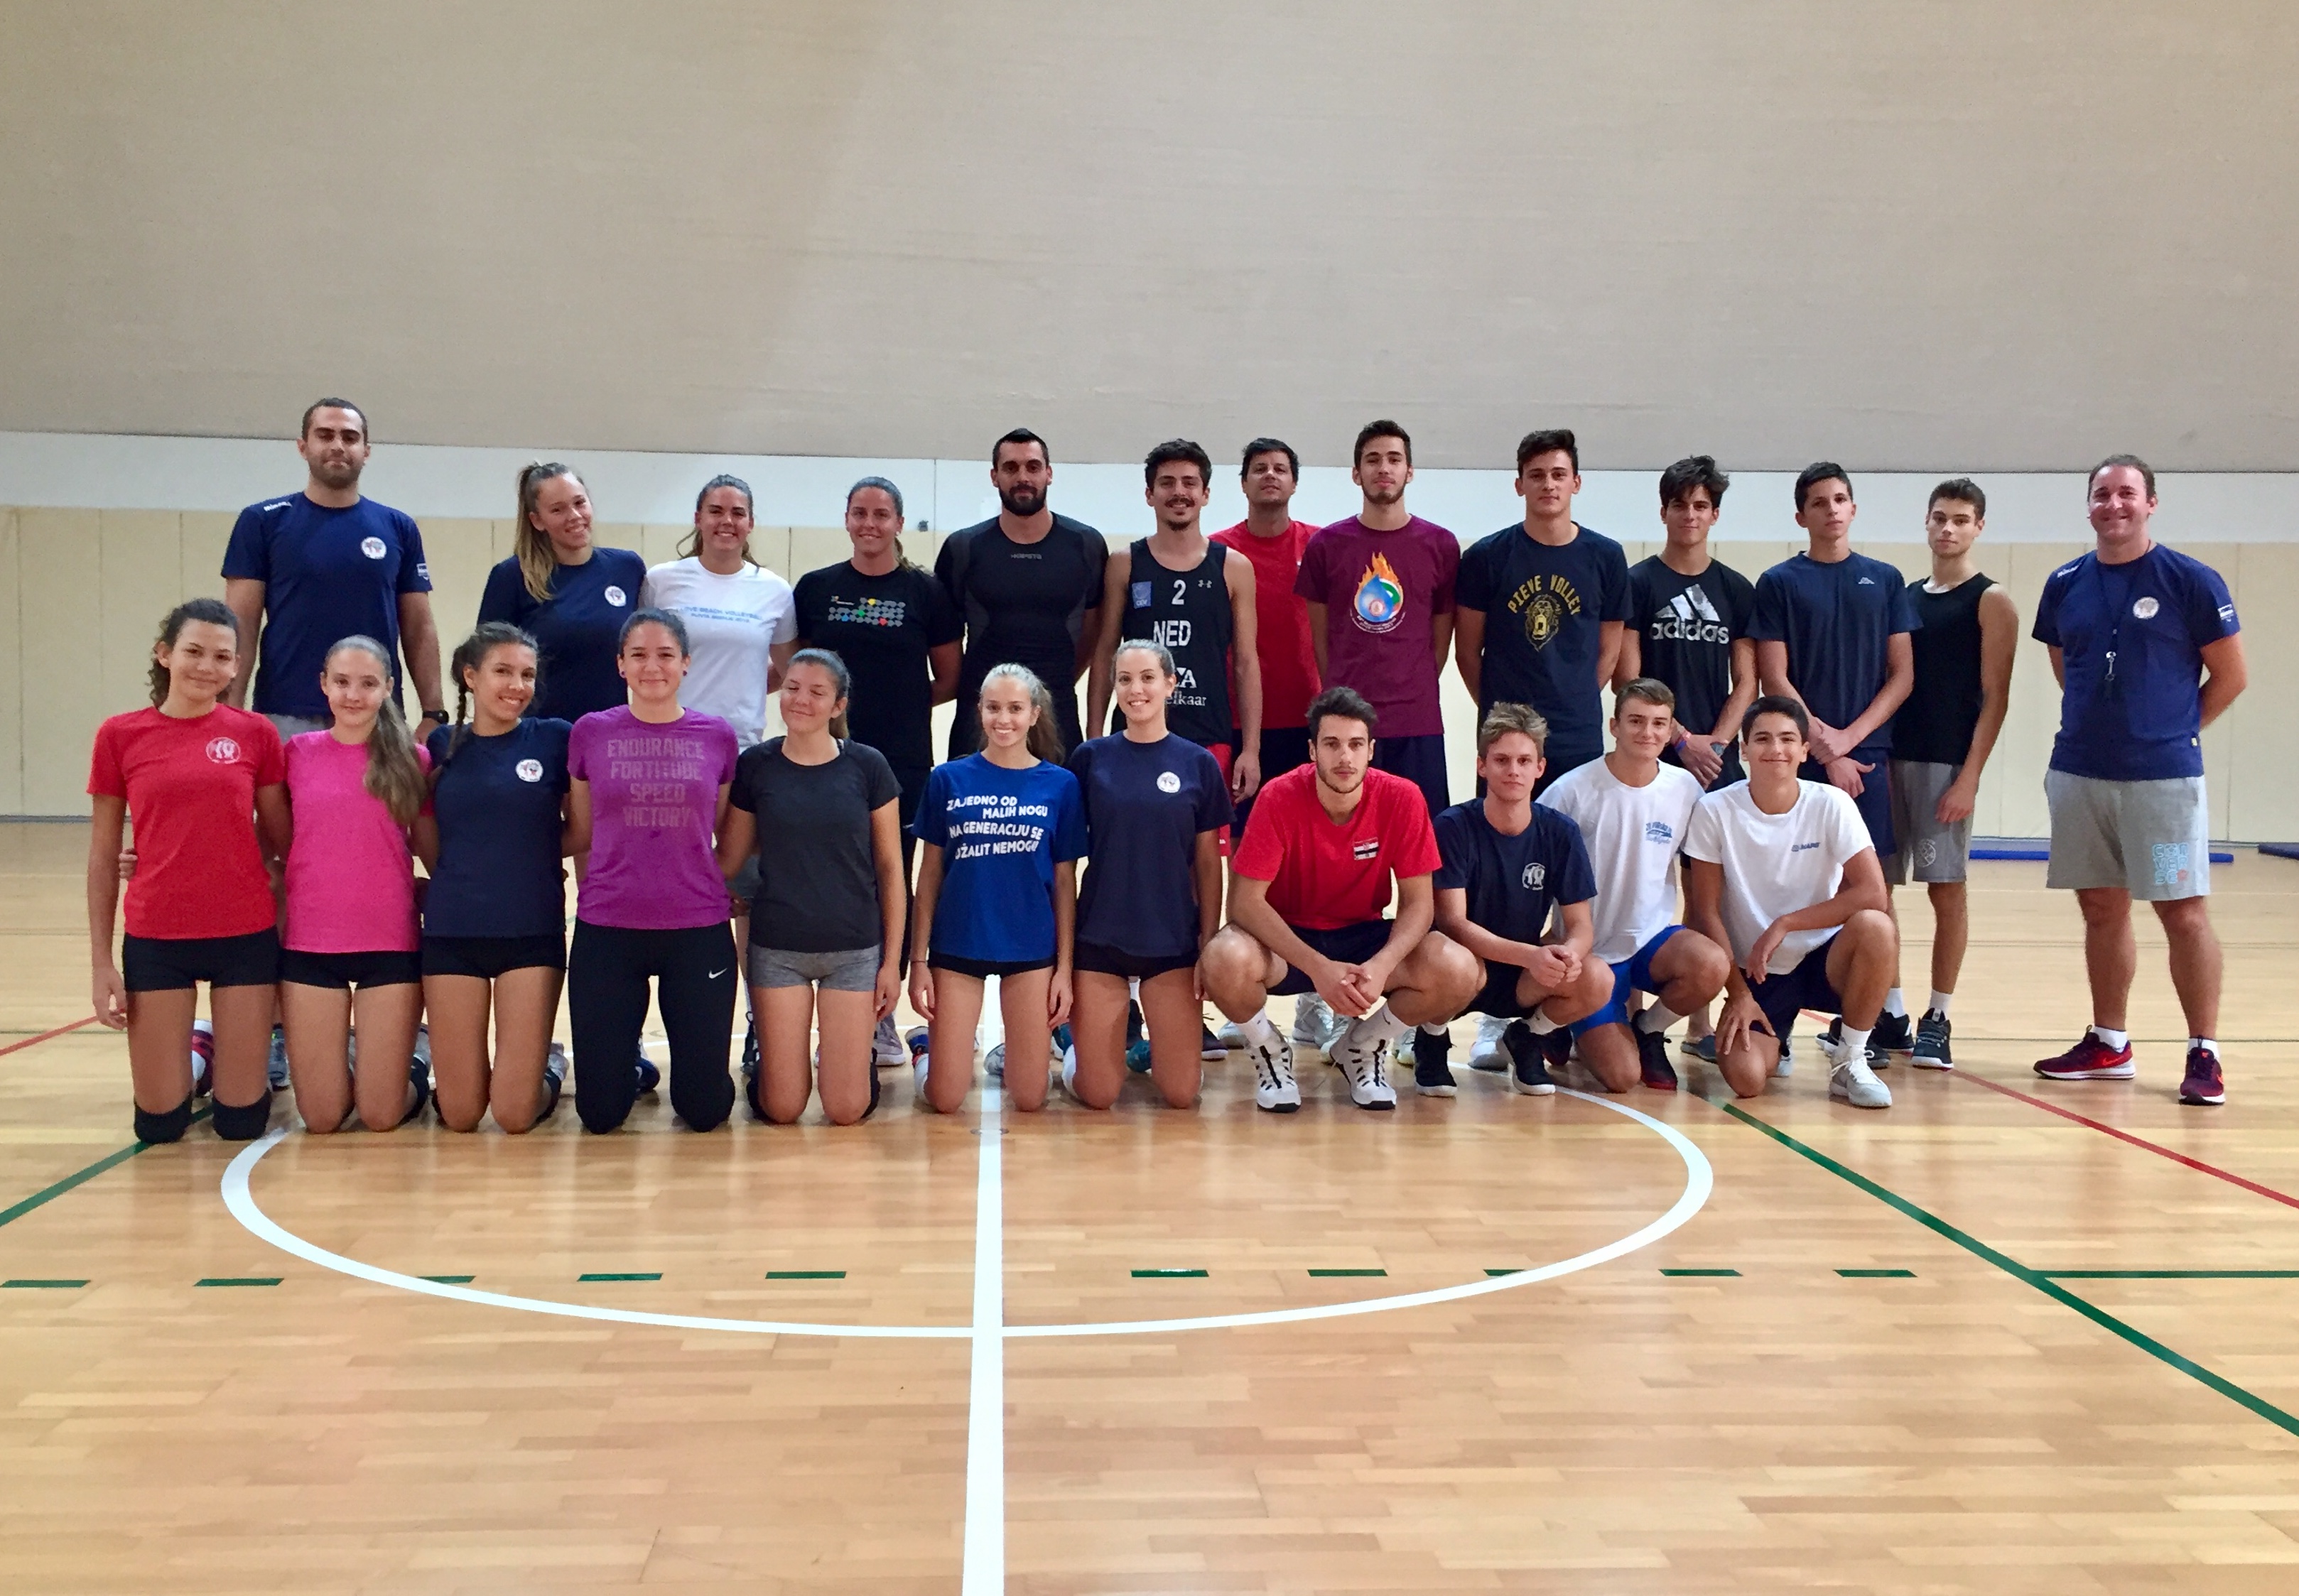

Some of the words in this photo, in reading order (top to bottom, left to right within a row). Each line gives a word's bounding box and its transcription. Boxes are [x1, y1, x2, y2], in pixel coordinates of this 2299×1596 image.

[1172, 579, 1186, 605] 2
[1508, 575, 1542, 614] PIEVE
[1550, 574, 1581, 616] VOLLEY
[1153, 619, 1192, 647] NED
[1650, 617, 1730, 644] adidas
[607, 737, 705, 760] ENDURANCE
[629, 783, 686, 803] SPEED
[946, 795, 997, 811] ZAJEDNO
[1000, 796, 1018, 807] OD
[622, 807, 692, 827] VICTORY
[982, 806, 1017, 820] MALIH
[1018, 805, 1048, 817] NOGU
[948, 823, 964, 839] NA
[963, 821, 1030, 837] GENERACIJU
[1030, 826, 1044, 841] SE
